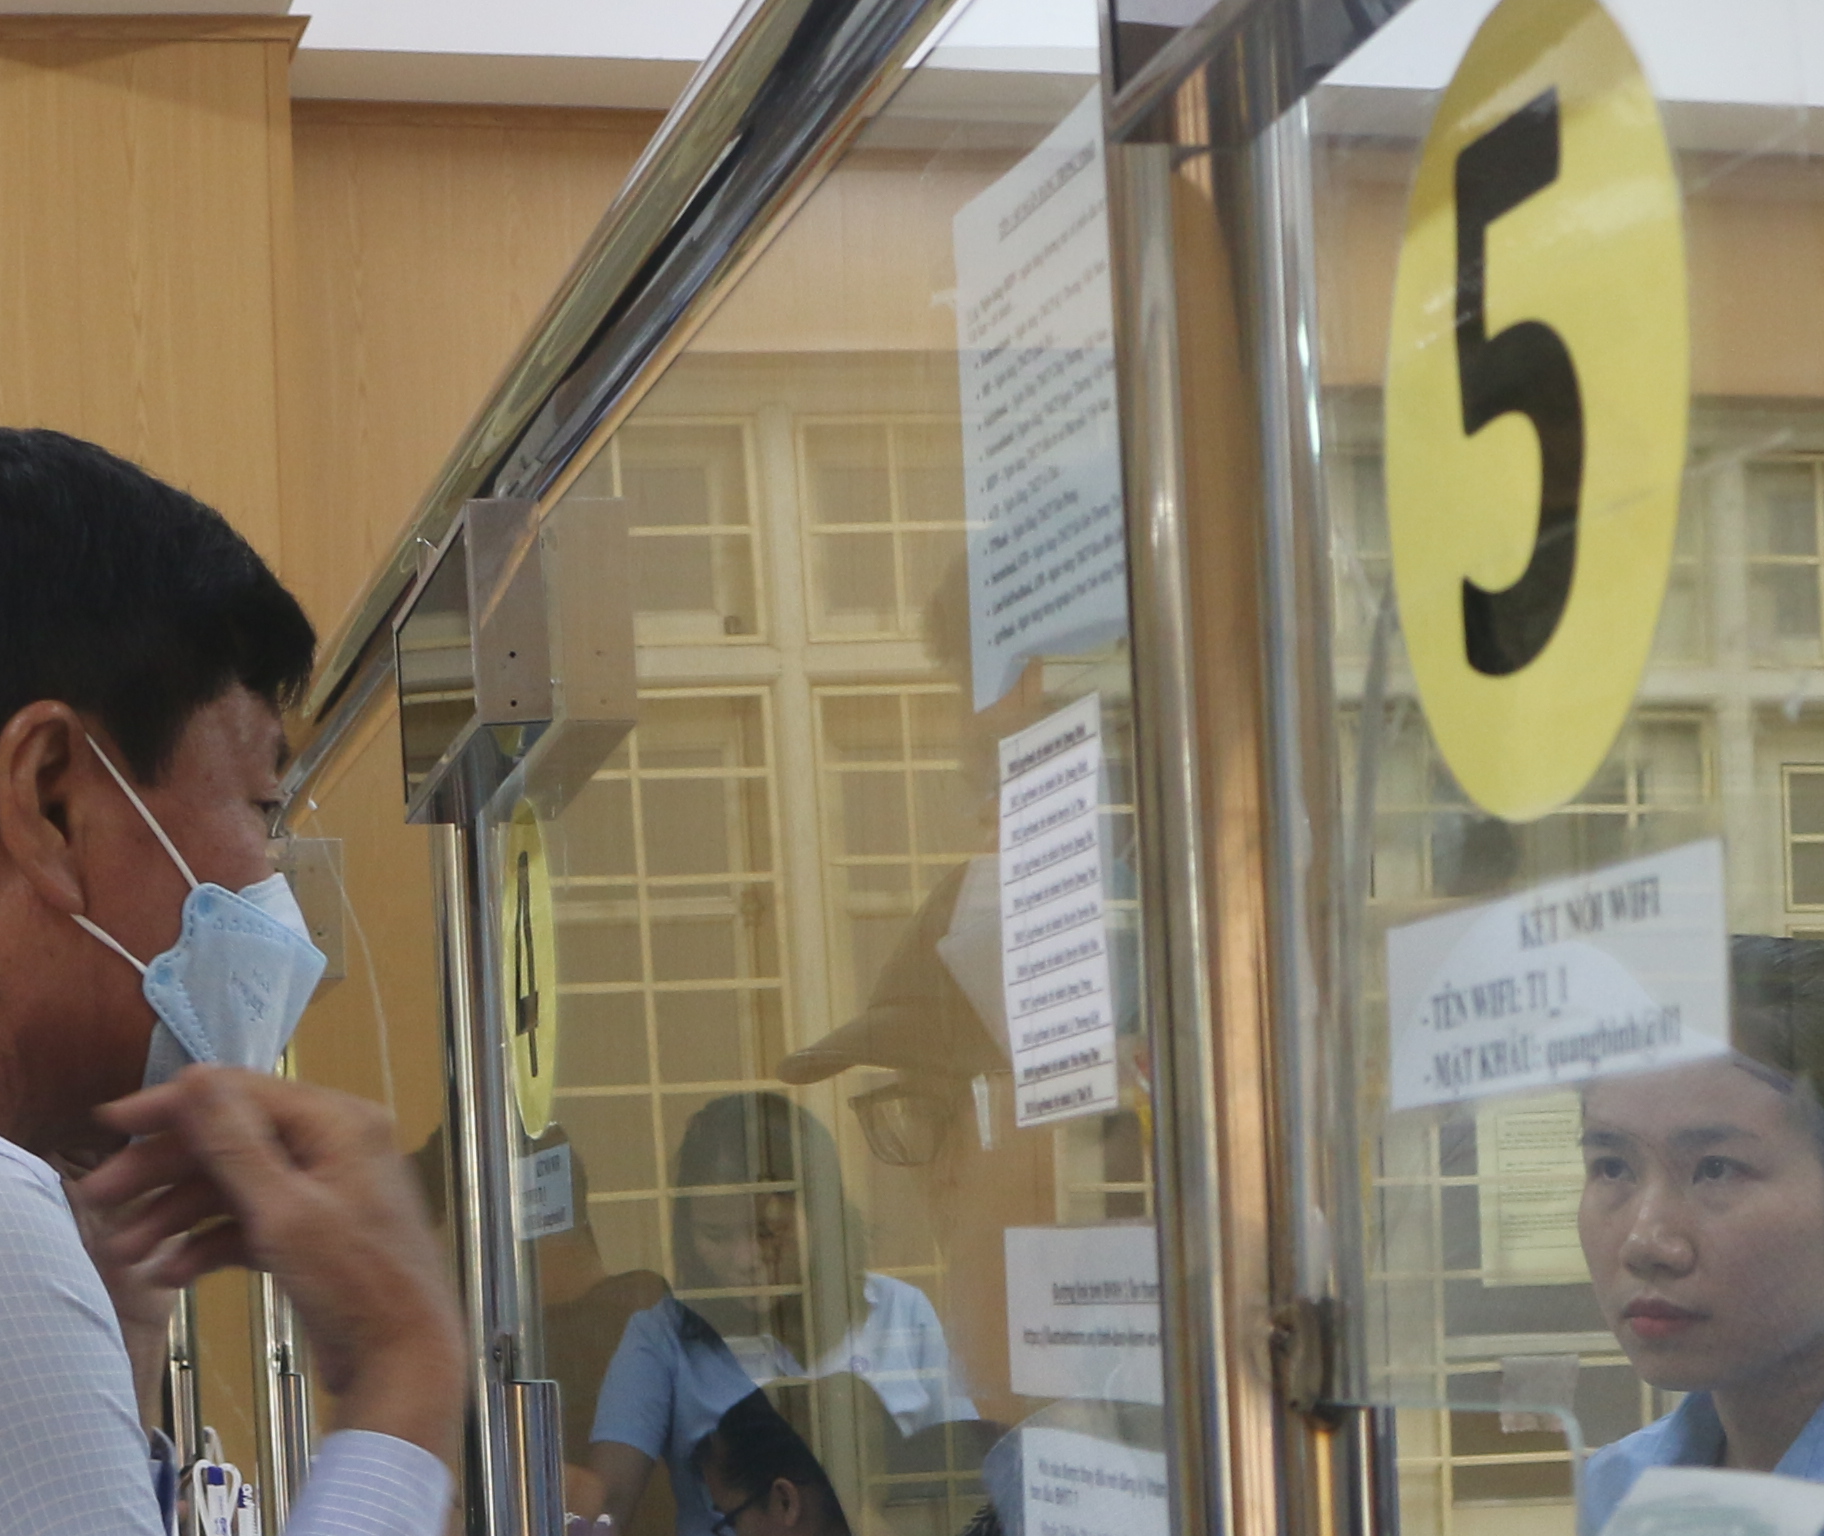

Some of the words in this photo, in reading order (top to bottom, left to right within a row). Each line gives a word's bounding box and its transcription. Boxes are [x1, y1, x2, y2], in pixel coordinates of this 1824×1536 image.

[1453, 87, 1586, 676] 5
[515, 850, 539, 1077] 4
[1608, 875, 1662, 922] WIFI
